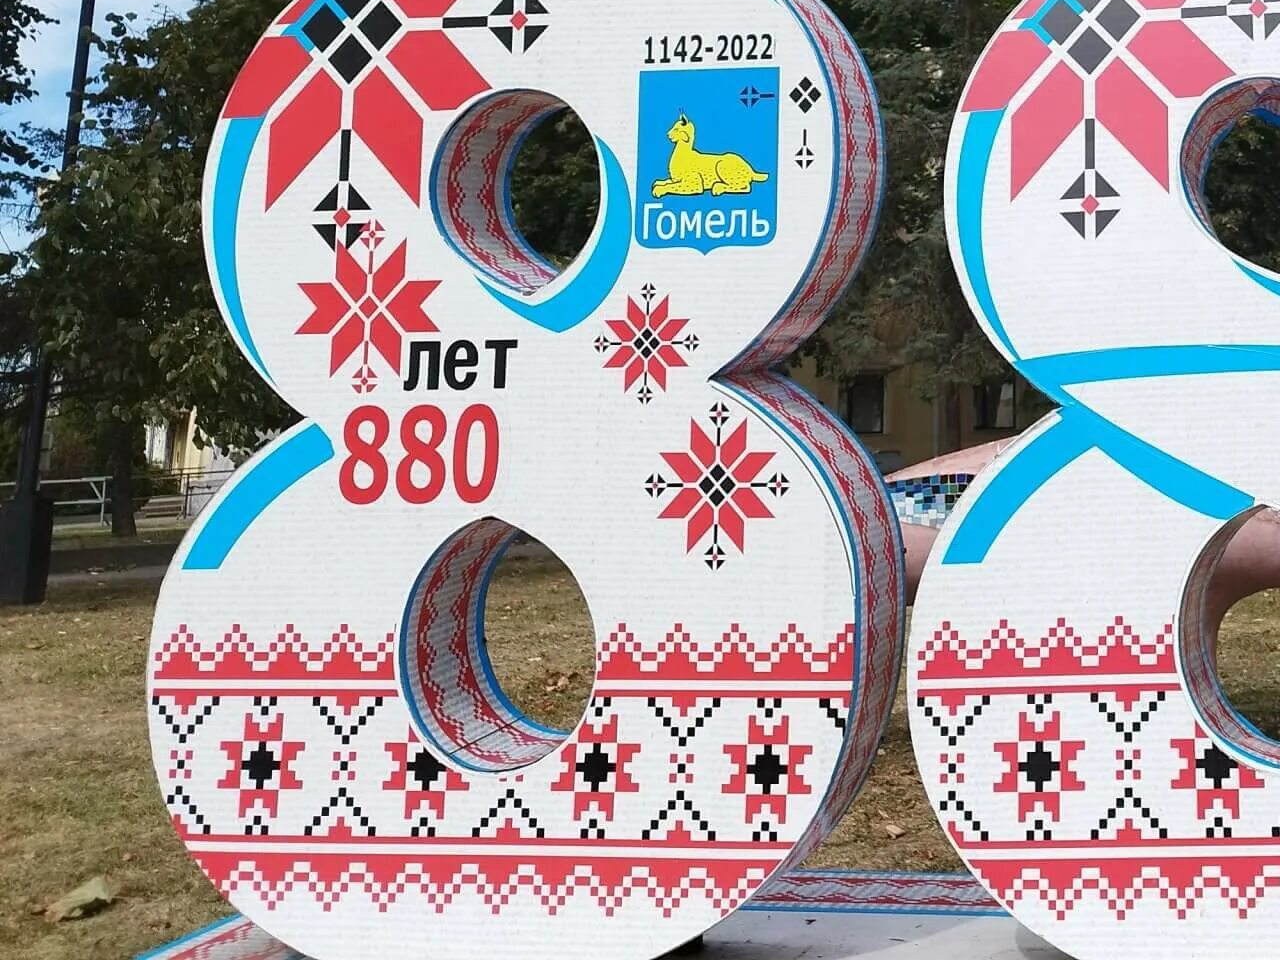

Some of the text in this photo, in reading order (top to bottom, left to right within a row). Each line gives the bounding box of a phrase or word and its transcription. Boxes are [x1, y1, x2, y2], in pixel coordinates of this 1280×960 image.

[643, 34, 773, 65] 1142-2022
[641, 203, 771, 241] Гомель
[403, 338, 518, 392] лет
[338, 404, 500, 505] 880
